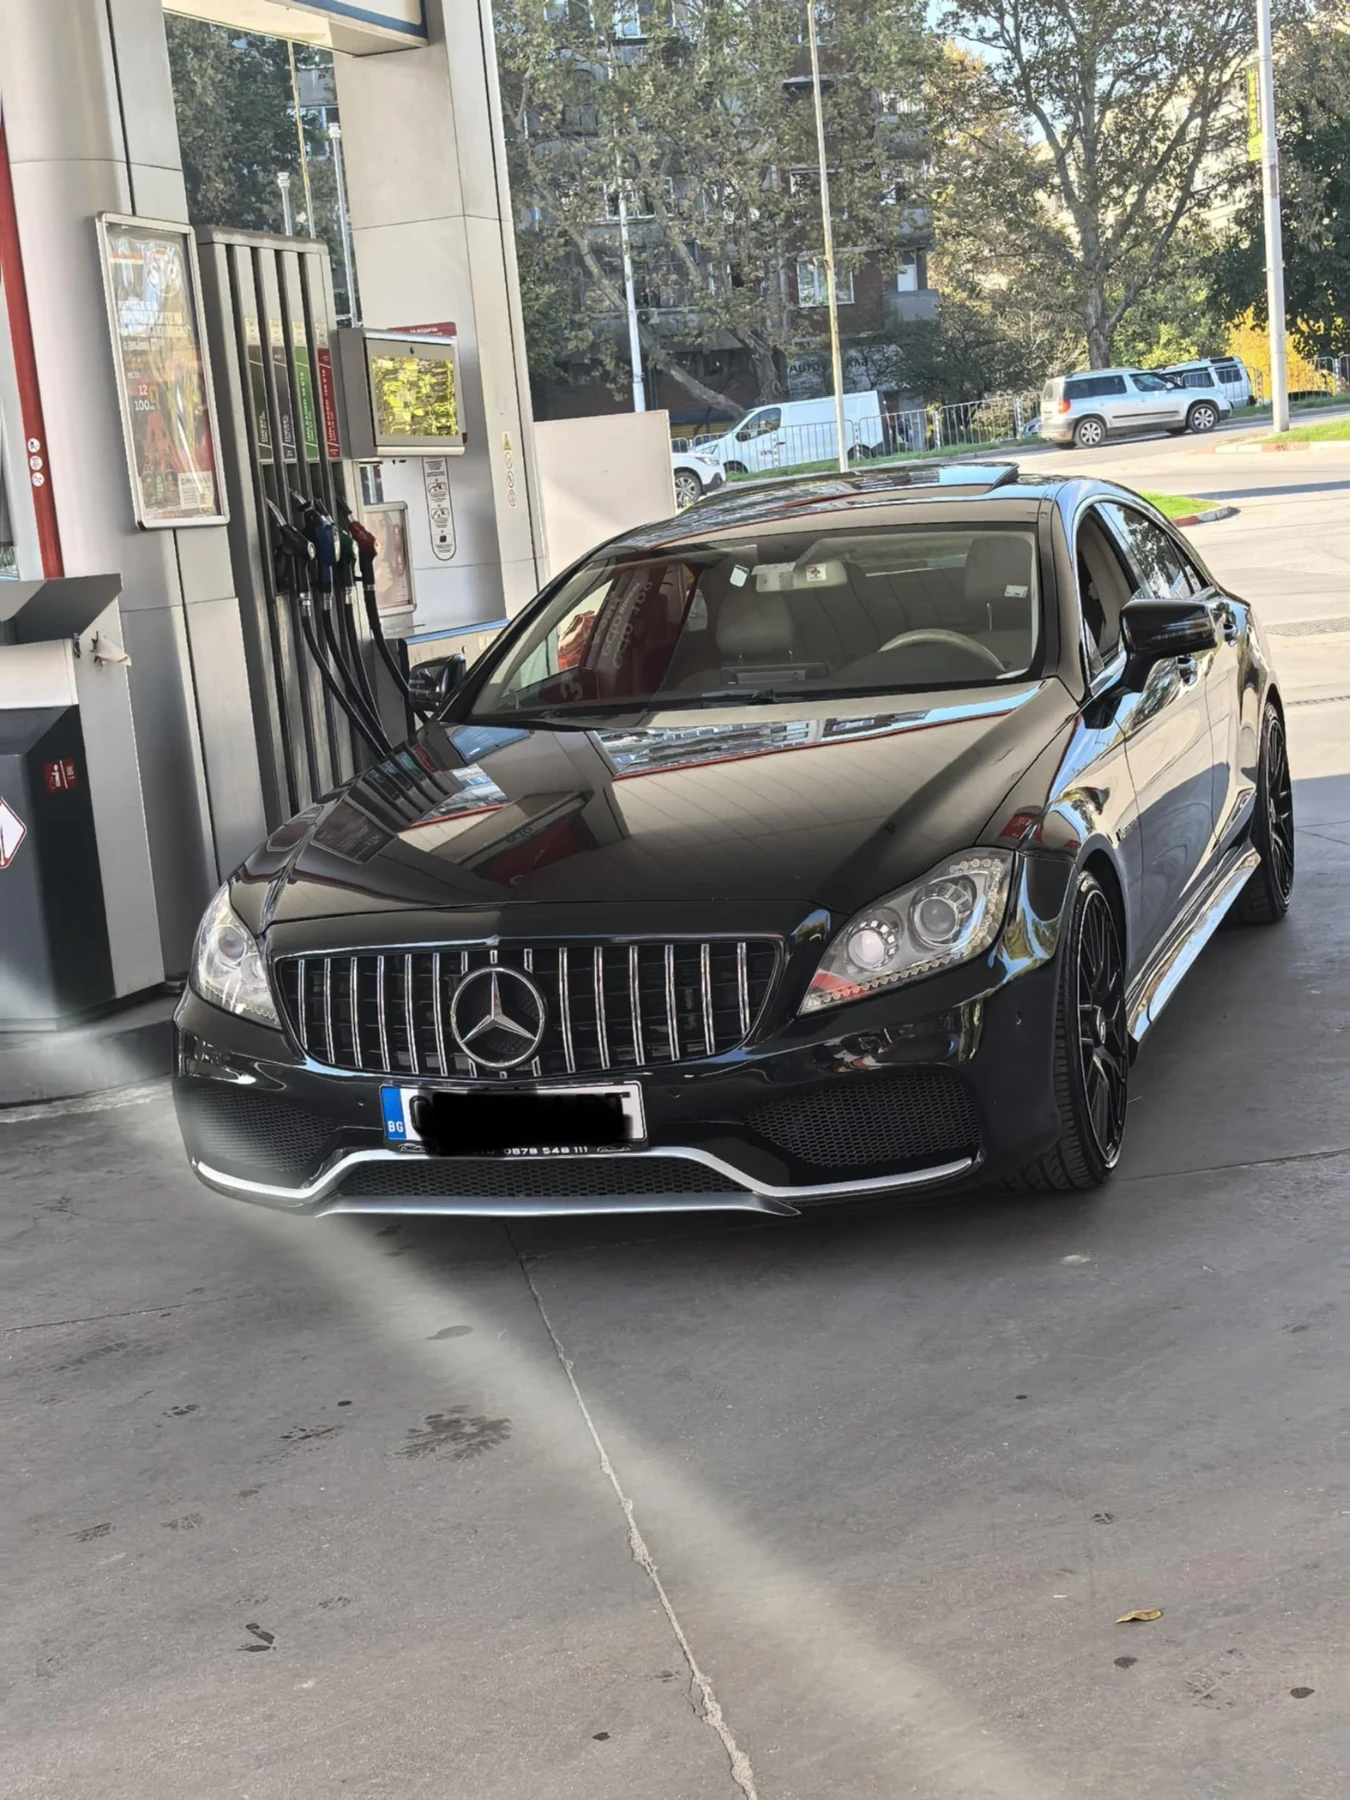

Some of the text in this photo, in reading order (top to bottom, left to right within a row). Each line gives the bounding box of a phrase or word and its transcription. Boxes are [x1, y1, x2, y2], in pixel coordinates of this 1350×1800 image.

[134, 400, 150, 411] 100
[387, 1120, 404, 1133] BG
[542, 1146, 570, 1155] 548
[573, 1145, 588, 1154] 111
